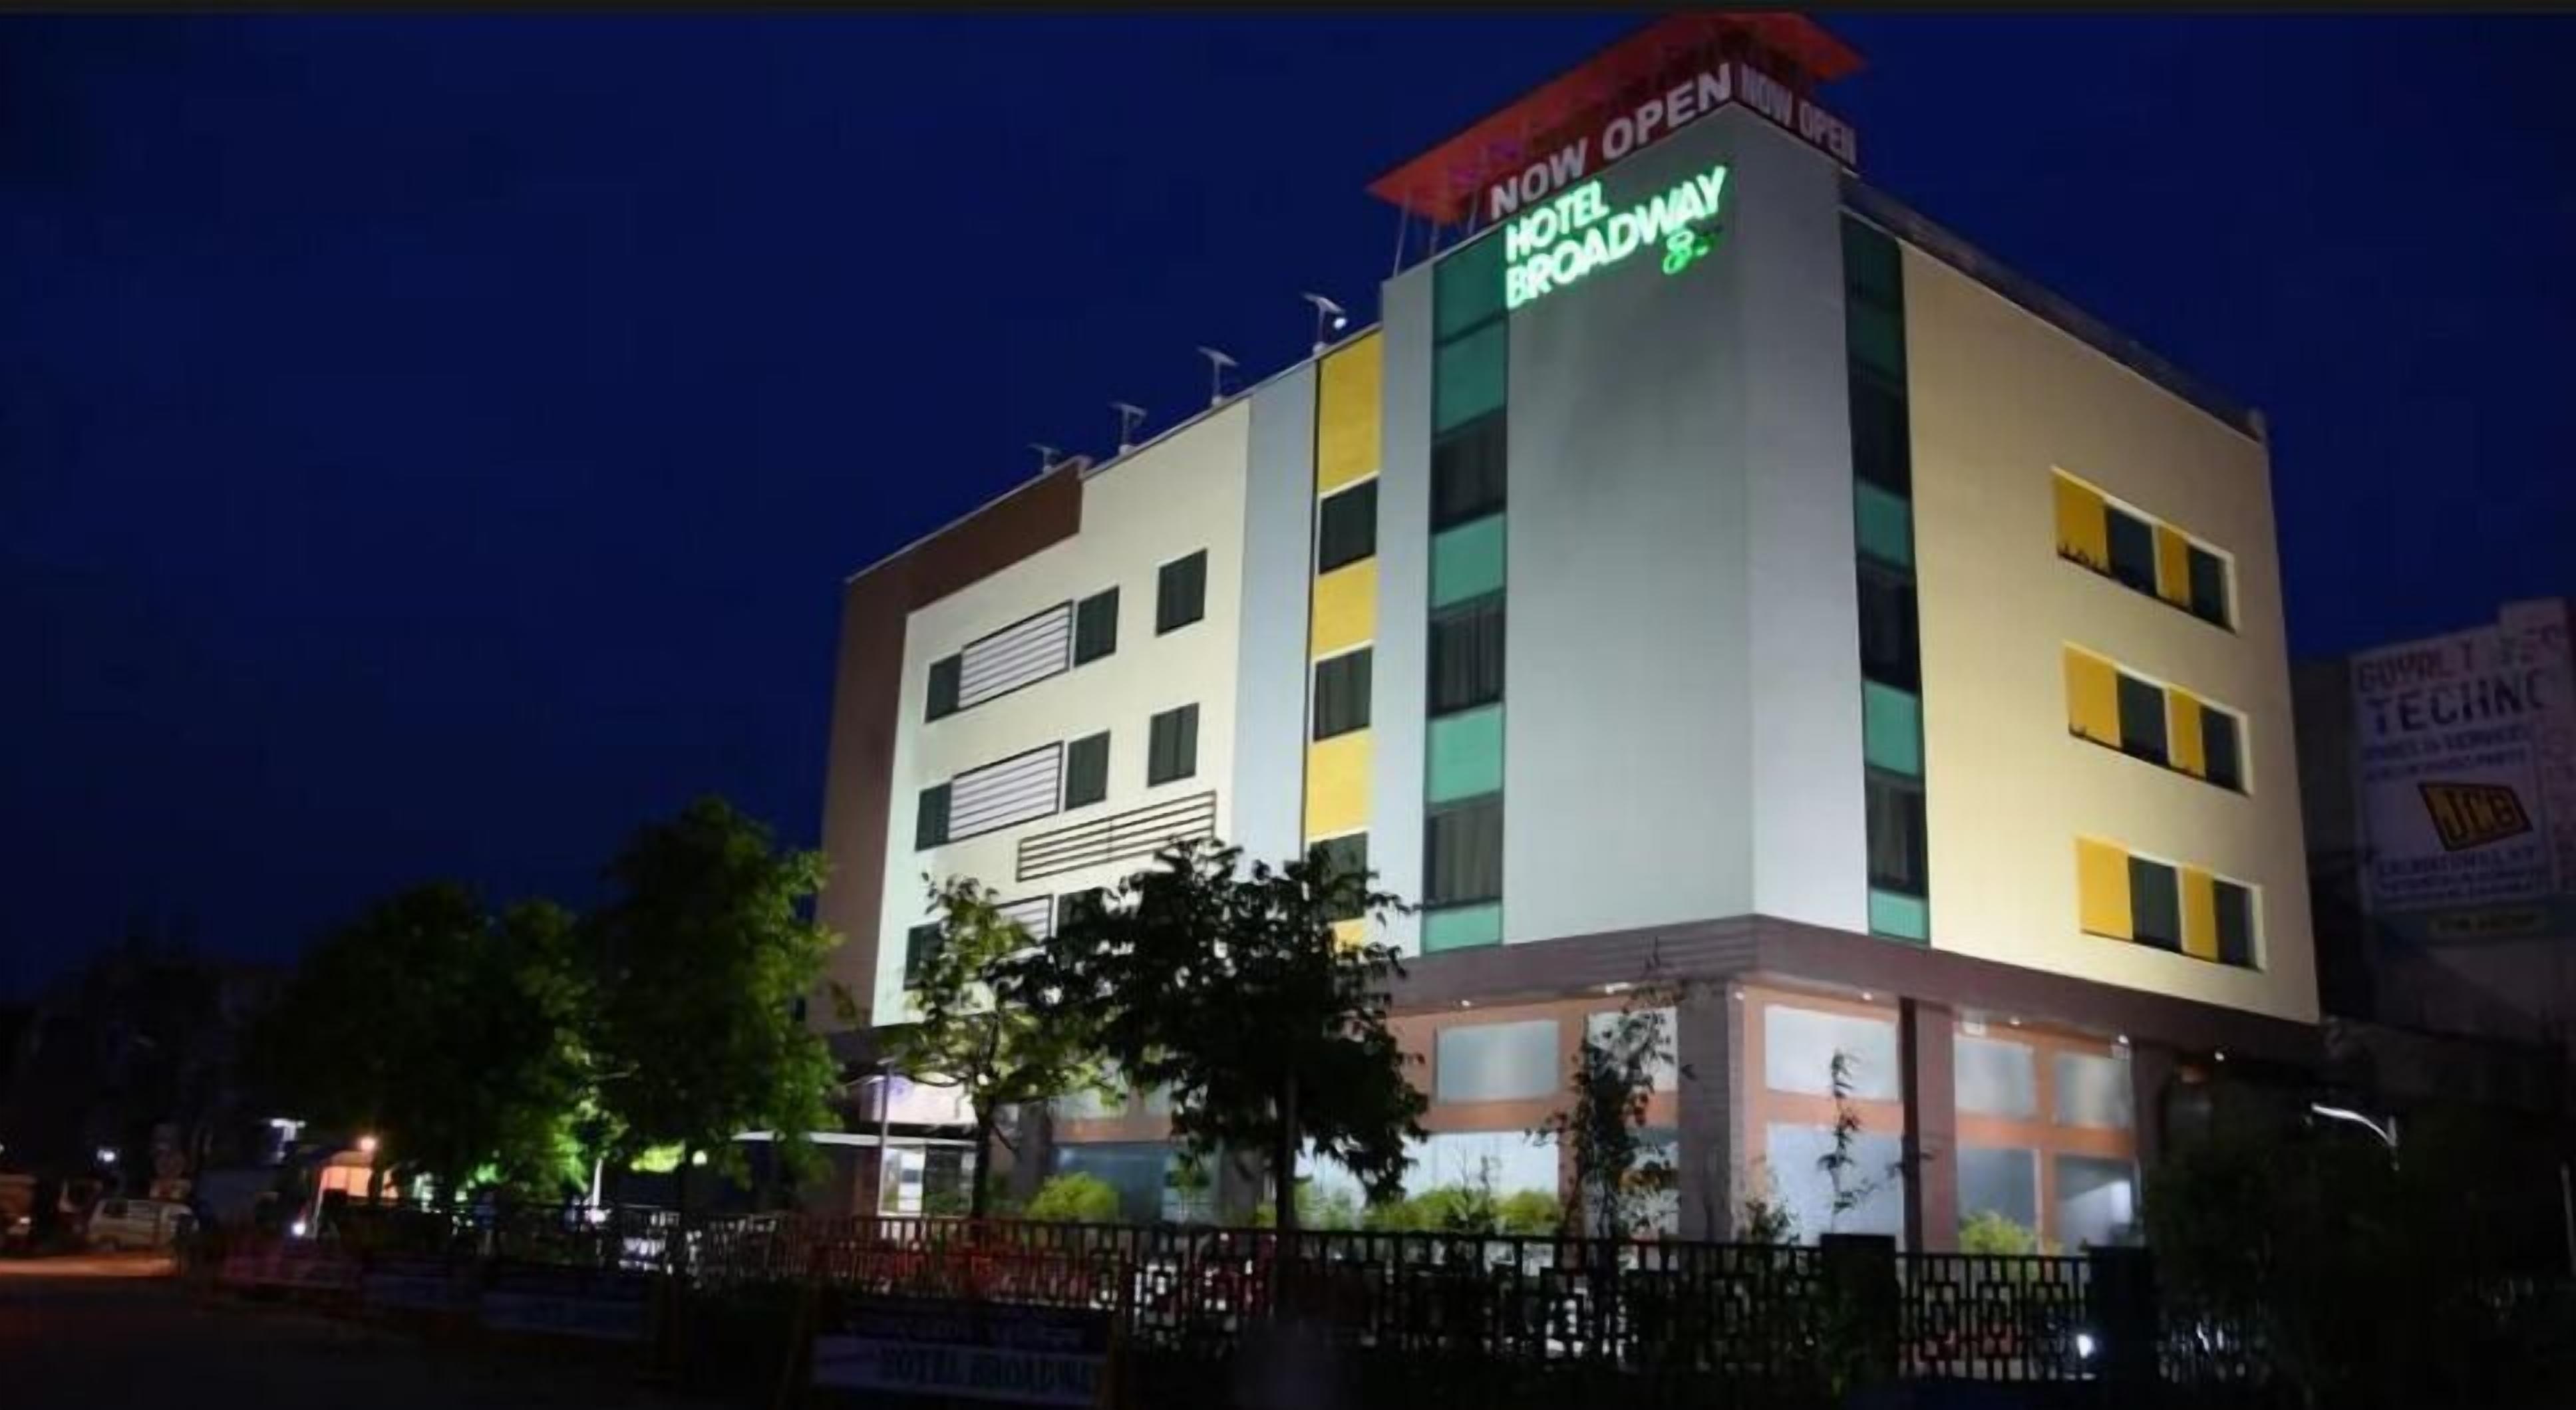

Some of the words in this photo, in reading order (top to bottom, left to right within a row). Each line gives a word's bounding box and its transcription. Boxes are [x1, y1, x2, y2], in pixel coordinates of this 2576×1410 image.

[1490, 138, 1587, 219] NOW
[1601, 62, 1731, 161] OPEN
[1740, 64, 1792, 127] NOW
[1799, 100, 1857, 165] OPEN
[1506, 180, 1610, 262] HOTEL
[1506, 166, 1728, 310] BROADWAY
[2440, 787, 2519, 843] JCB
